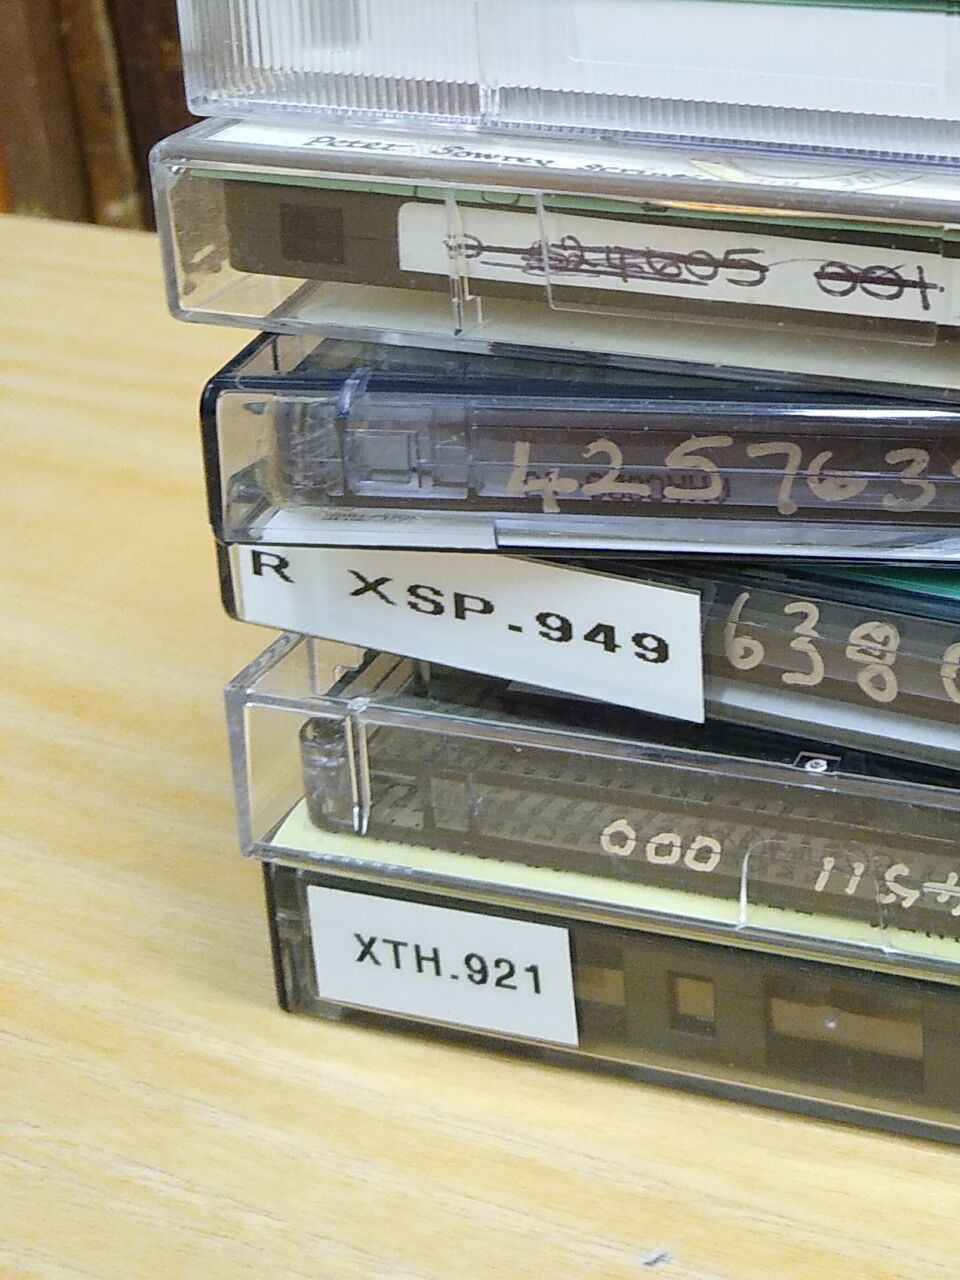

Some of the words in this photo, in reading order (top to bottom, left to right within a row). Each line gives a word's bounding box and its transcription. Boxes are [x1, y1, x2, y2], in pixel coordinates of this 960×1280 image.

[302, 136, 413, 151] Peter
[250, 550, 296, 584] R
[349, 569, 671, 666] XSP.949
[354, 932, 542, 995] XTH.921
